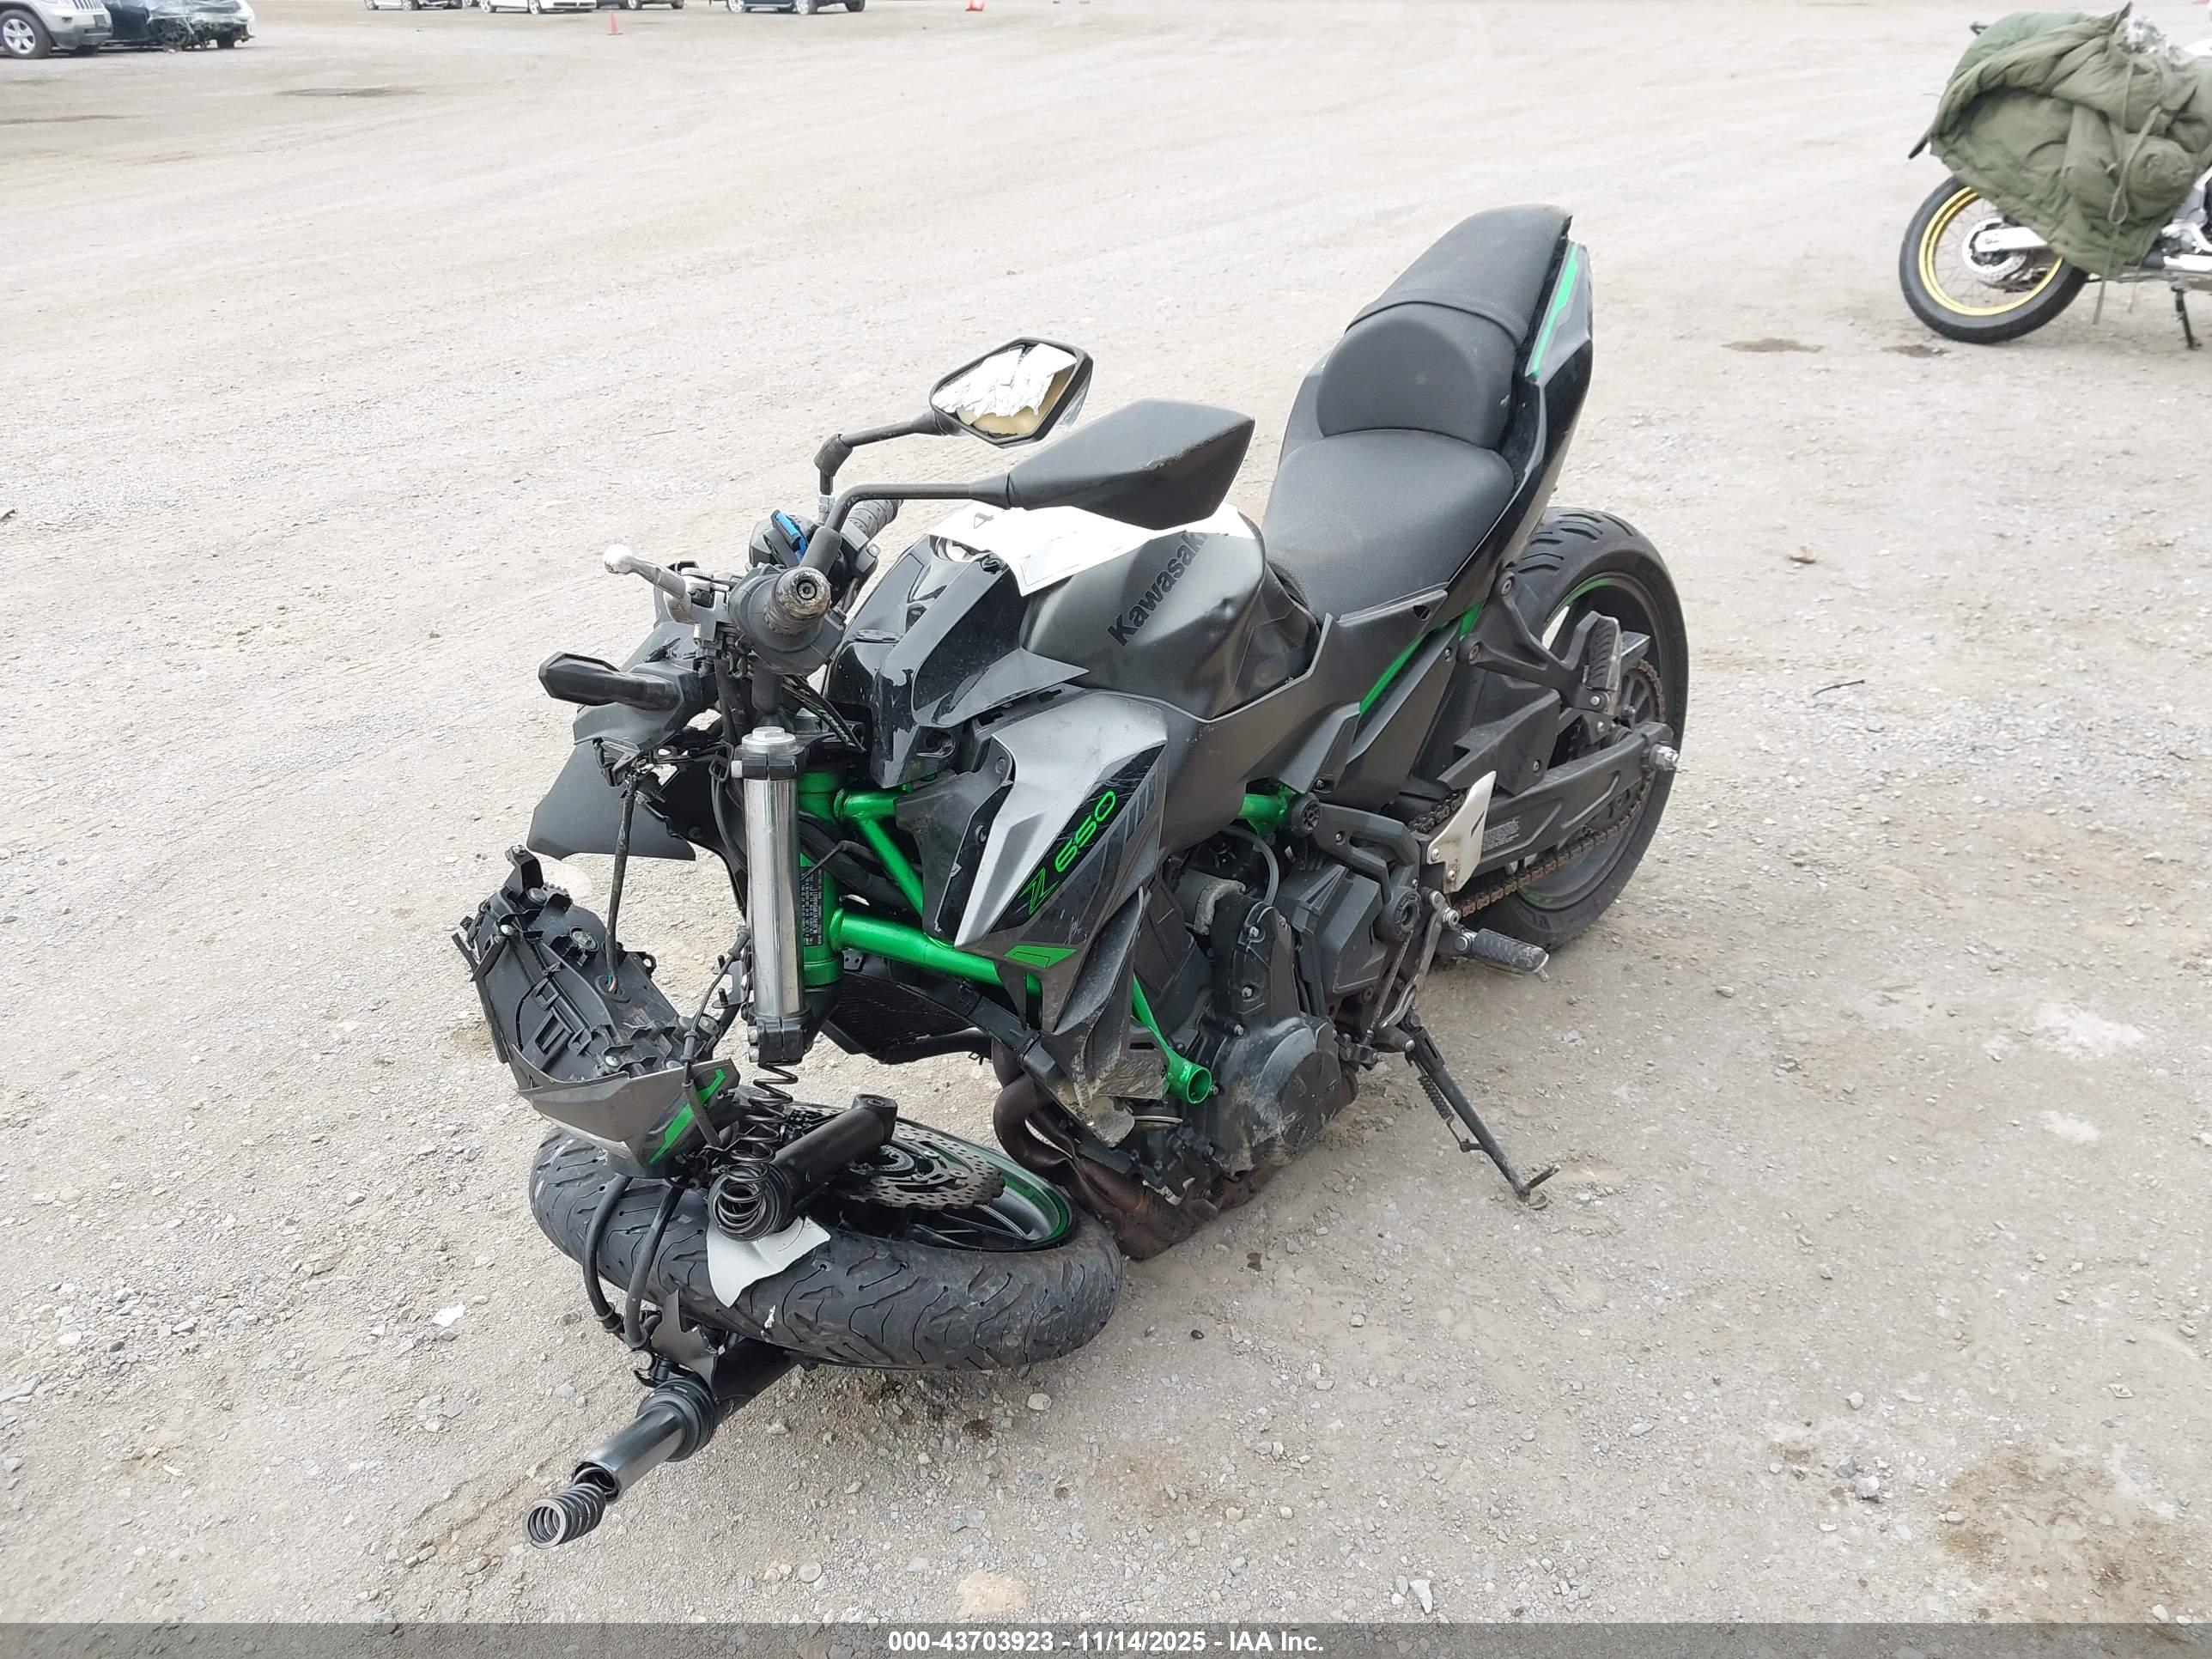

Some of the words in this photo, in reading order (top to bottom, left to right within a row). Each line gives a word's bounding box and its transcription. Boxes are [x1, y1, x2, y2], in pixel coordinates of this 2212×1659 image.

[1107, 531, 1208, 647] Kawasak
[1018, 866, 1060, 915] Z
[1054, 790, 1116, 873] 650
